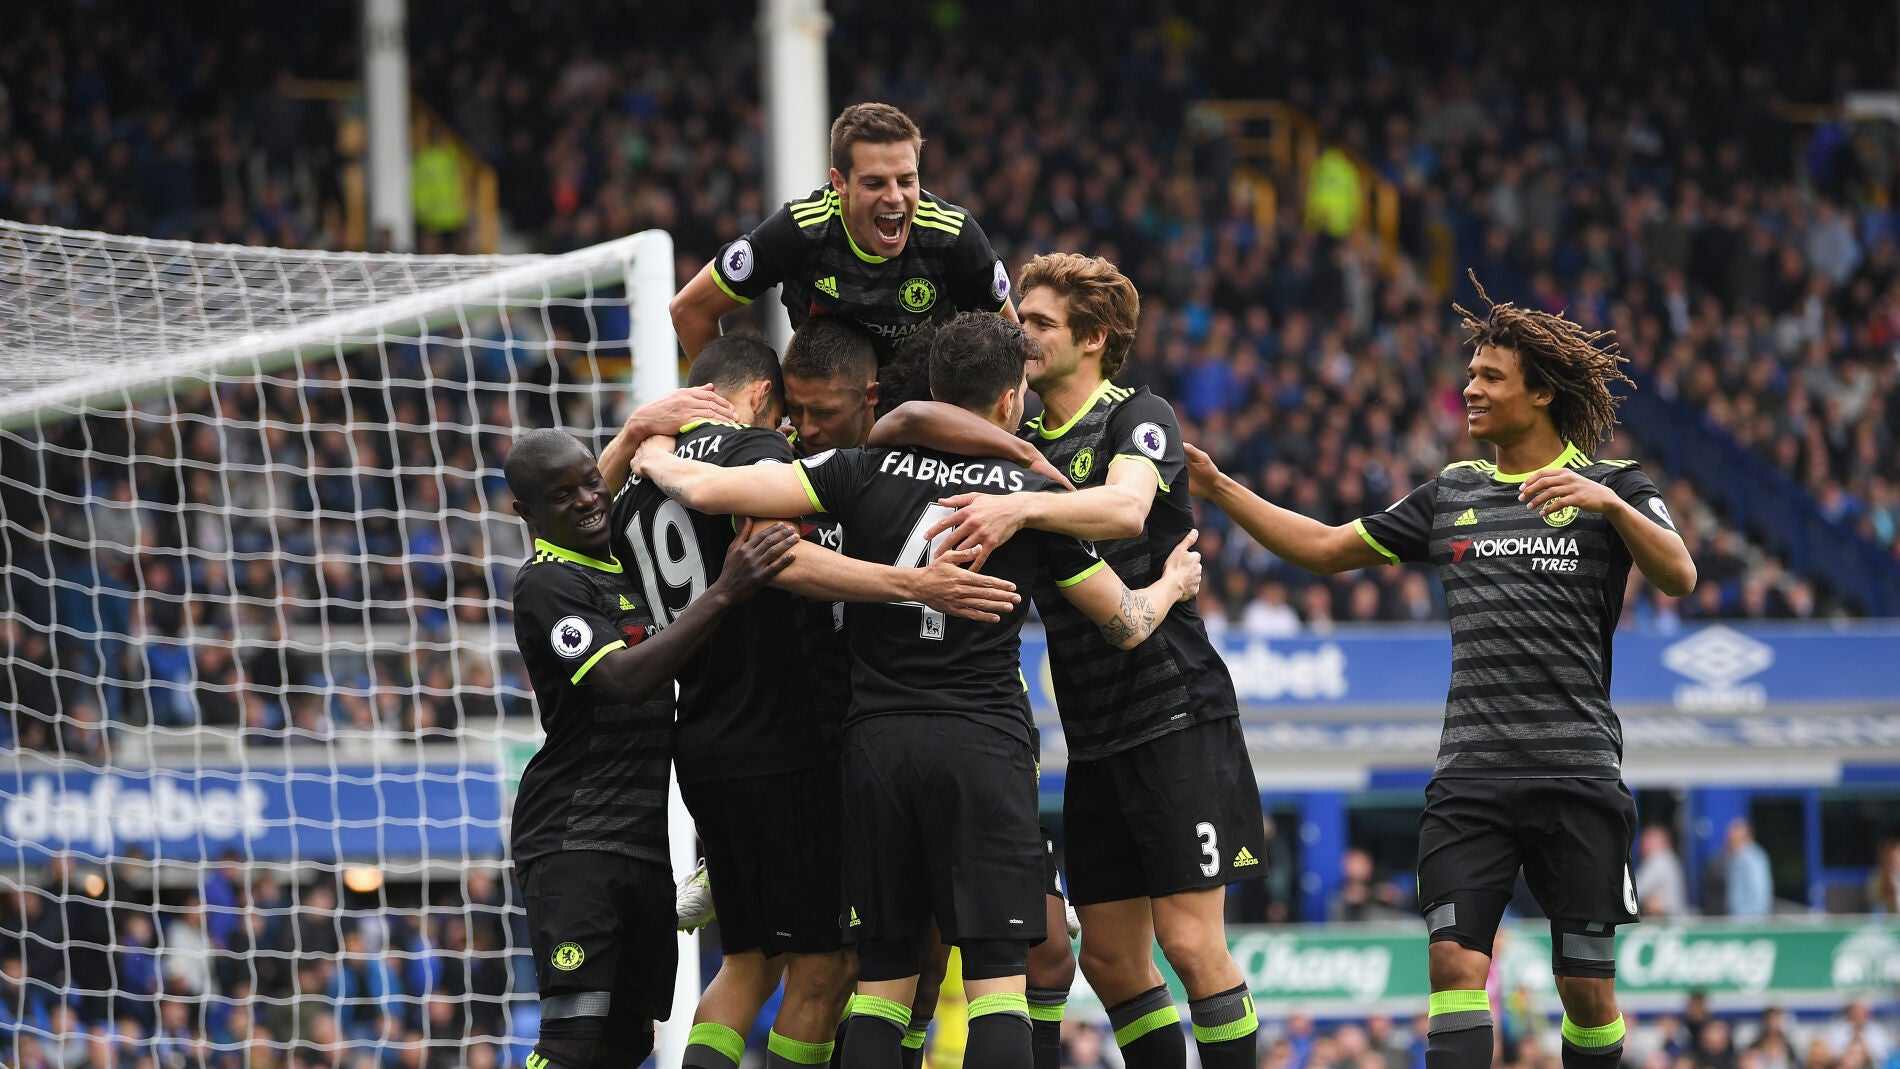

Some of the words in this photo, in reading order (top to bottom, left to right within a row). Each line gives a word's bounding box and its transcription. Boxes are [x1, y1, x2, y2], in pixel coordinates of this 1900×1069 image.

[814, 281, 840, 299] adidas
[674, 435, 722, 461] OSTA
[624, 498, 708, 630] 19
[886, 501, 958, 641] 4
[1472, 537, 1580, 558] YOKOHAMA
[1531, 558, 1579, 571] TYRES
[4, 775, 268, 853] dafabet
[1195, 822, 1220, 877] 3
[1233, 858, 1259, 868] adidas
[1232, 931, 1392, 1001] Chang
[1618, 924, 1778, 995] Chang
